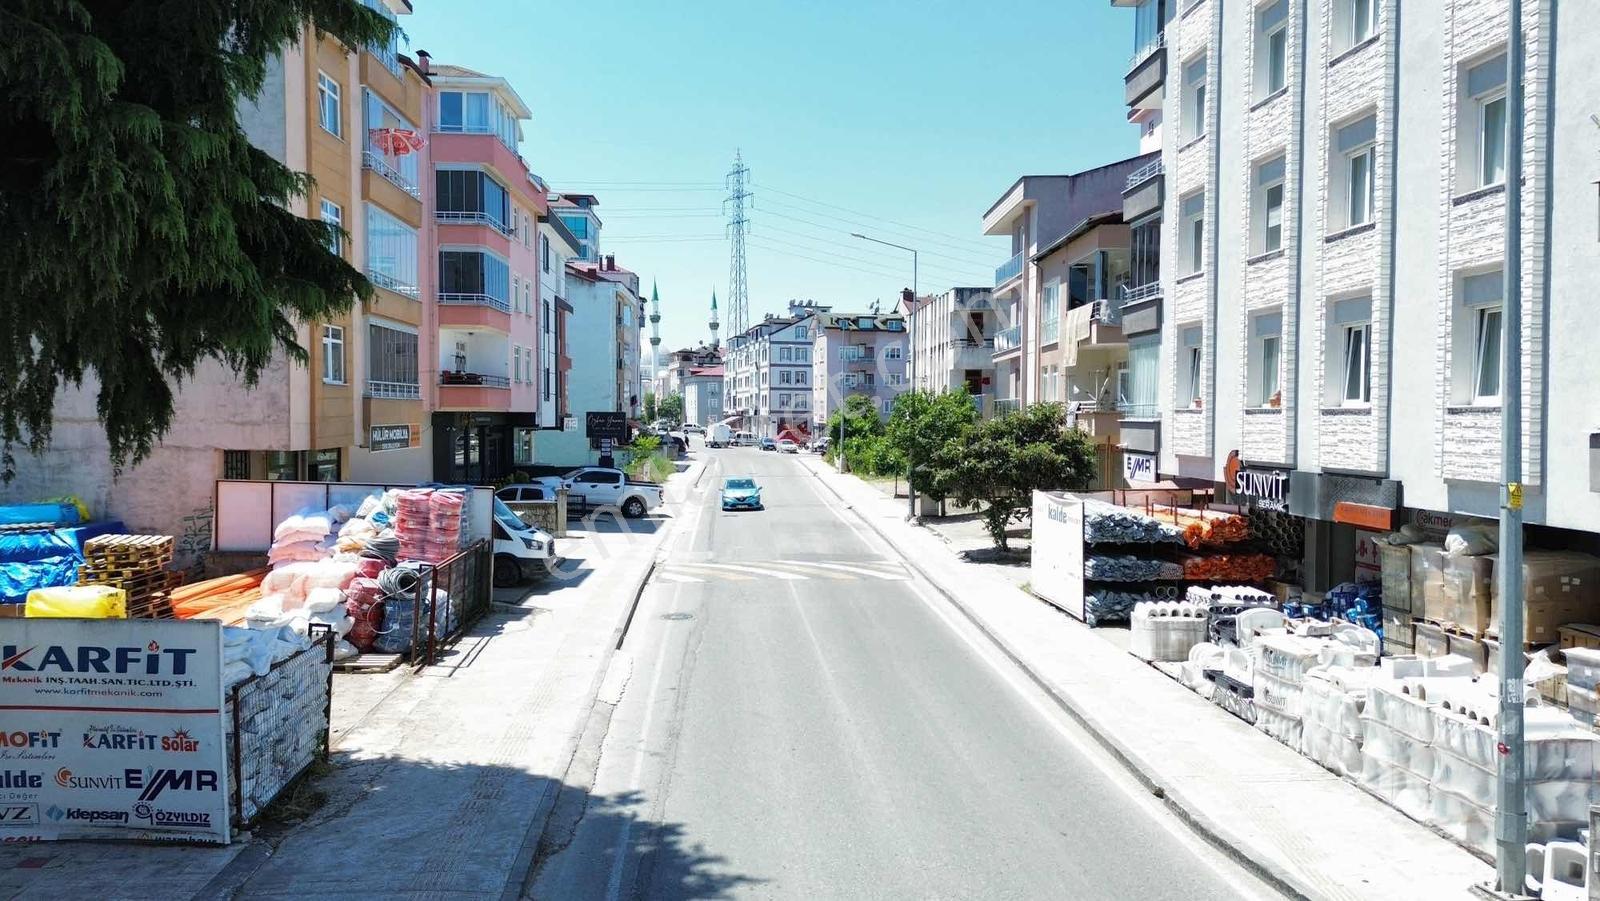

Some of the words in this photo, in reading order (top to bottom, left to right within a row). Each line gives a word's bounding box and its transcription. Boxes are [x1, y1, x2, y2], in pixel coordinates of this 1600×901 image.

[3, 676, 43, 684] Mekanik
[35, 687, 163, 697] www.karfitmekanik.com
[161, 735, 199, 752] Solar
[66, 808, 129, 823] klepsan
[156, 809, 210, 823] ÖZYILDIZ
